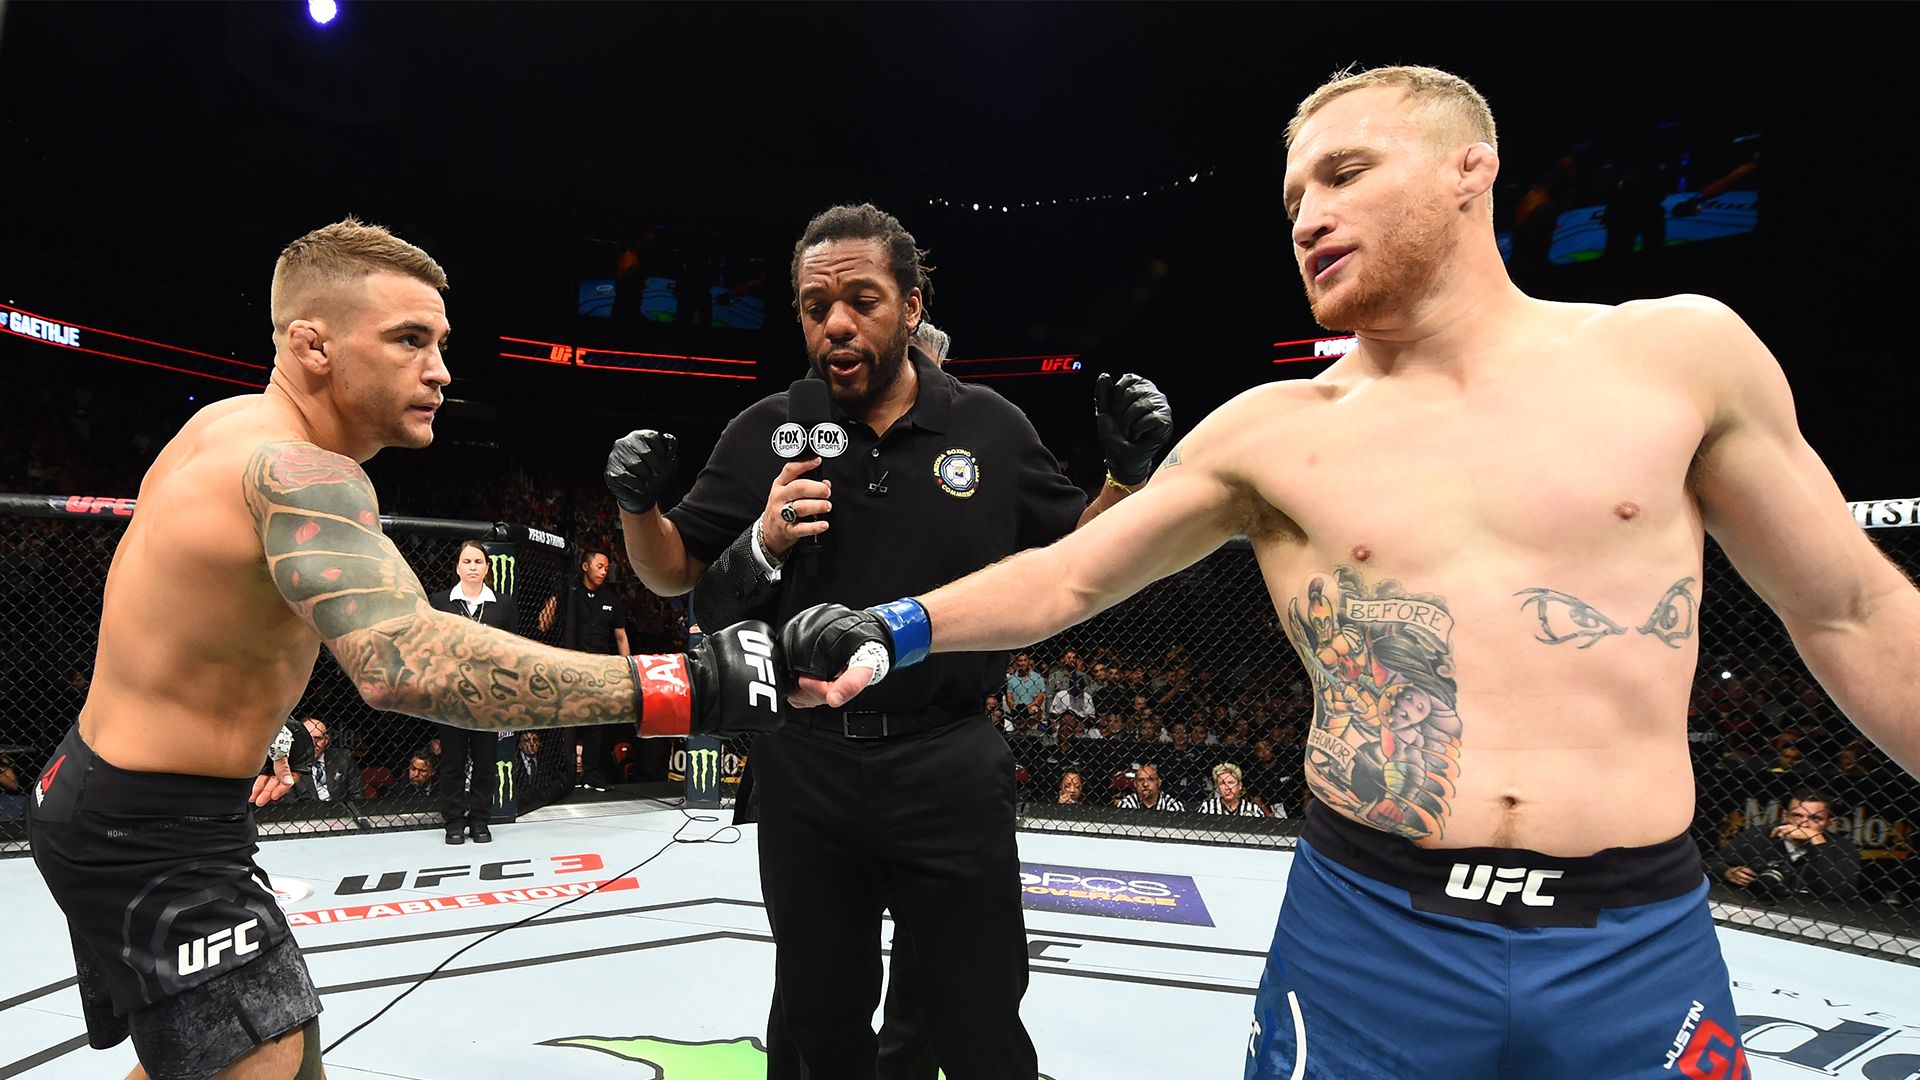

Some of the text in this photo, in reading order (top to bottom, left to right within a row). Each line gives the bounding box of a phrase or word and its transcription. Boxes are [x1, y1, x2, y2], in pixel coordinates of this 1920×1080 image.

[10, 312, 80, 347] GAETHJE
[550, 346, 586, 365] UFC
[1041, 358, 1073, 371] UFC
[779, 430, 799, 444] FOX
[817, 430, 839, 444] FOX
[65, 495, 136, 516] UFC
[1350, 602, 1445, 631] BEFORE
[737, 630, 778, 713] UFC
[334, 854, 604, 895] UFC 3
[1444, 863, 1565, 906] UFC
[492, 882, 599, 903] NOW
[1021, 885, 1176, 906] OVERAGE
[178, 918, 259, 976] UFC
[1663, 1000, 1704, 1069] JUSTIN
